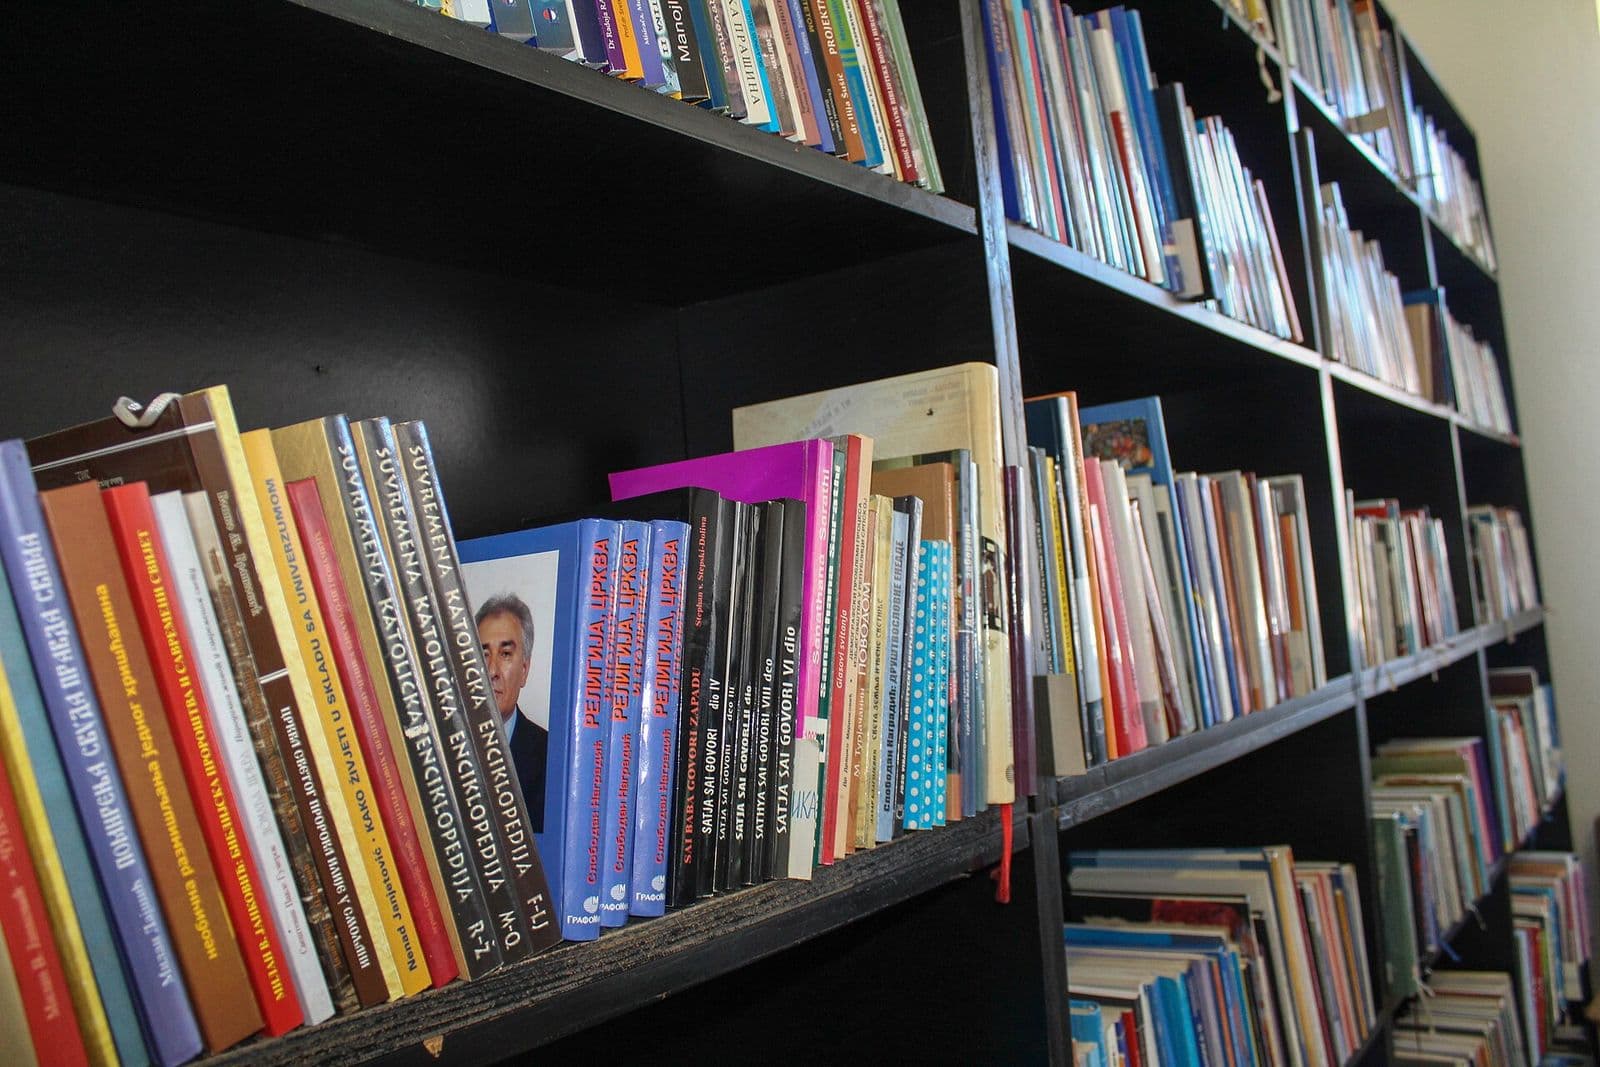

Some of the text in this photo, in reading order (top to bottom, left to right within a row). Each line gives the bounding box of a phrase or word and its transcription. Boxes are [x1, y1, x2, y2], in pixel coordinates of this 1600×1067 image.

[602, 11, 612, 37] Radoja
[607, 38, 615, 49] Dr
[734, 21, 760, 104] ПРАШИНА
[873, 41, 885, 63] BOSNE
[834, 72, 857, 134] dr Ilija Šušić
[879, 65, 896, 104] BIBLIOTEKE
[896, 128, 907, 146] KROZ
[136, 530, 162, 585] СВИЈЕТ
[264, 477, 307, 604] UNIVERZUMOM
[812, 468, 829, 663] Sanathana Sarathi
[40, 606, 81, 689] ПРАВДА
[152, 587, 187, 674] САВРЕМЕНИ
[301, 609, 316, 633] SA
[583, 538, 609, 729] РЕЛИГИЈА, ЦРКВА
[612, 539, 639, 721] РЕЛИГИЈА, ЦРКВА
[653, 538, 678, 717] РЕЛИГИЈА, ЦРКВА
[695, 592, 703, 627] Stephan
[834, 609, 848, 687] Glasovi svitanja
[858, 581, 871, 676] ПОВОДОМ
[178, 676, 191, 688] И
[309, 637, 337, 704] SKLADU
[337, 444, 385, 586] SUVREMENA
[414, 735, 474, 903] ENCIKLOPEDIJA
[375, 446, 522, 951] SUVREMENA KATOLIČKA ENCIKLOPEDIJA M-Q
[407, 444, 547, 929] SUVREMENA KATOLIČKA ENCIKLOPEDIJA F-LJ
[761, 687, 771, 708] VIII
[181, 688, 217, 776] ПРОРОШТВА
[331, 709, 342, 722] U
[759, 713, 770, 762] GOVORI
[776, 627, 795, 833] SATJA SAI GOVORI VI dio
[855, 687, 865, 755] Турјачанин
[885, 685, 896, 747] Наградић:
[93, 583, 218, 959] необична размишљања једног хришћанина
[335, 726, 360, 785] ŽIVJETI
[683, 666, 700, 863] SAI BABA GOVORI ZAPADU
[701, 677, 720, 833] SATJA SAI GOVORI dio IV
[722, 744, 730, 784] GOVORI
[735, 685, 752, 839] SATJA SAI GOVORI II dio
[757, 767, 767, 786] SAI
[883, 750, 893, 811] Слободан
[85, 761, 137, 870] ПОМИРЕЊА
[207, 778, 242, 858] БИБЛИЈСКА
[278, 705, 302, 748] ЦРКВА
[292, 748, 317, 797] СВЕТОГ
[308, 798, 335, 856] ПРОРОКА
[325, 856, 347, 895] ИЛИЈЕ
[336, 894, 350, 906] У
[354, 789, 375, 832] KAKO
[587, 740, 603, 884] Слободан Наградић
[615, 733, 631, 872] Слободан Наградић
[655, 728, 670, 864] Слободан Наградић
[755, 791, 766, 838] SATHYA
[232, 858, 266, 935] ЈАНКОВИЋ:
[371, 846, 417, 971] Nenad Janjetović
[148, 934, 175, 986] Милан
[257, 935, 270, 949] В.
[262, 950, 286, 1000] МИЛАН
